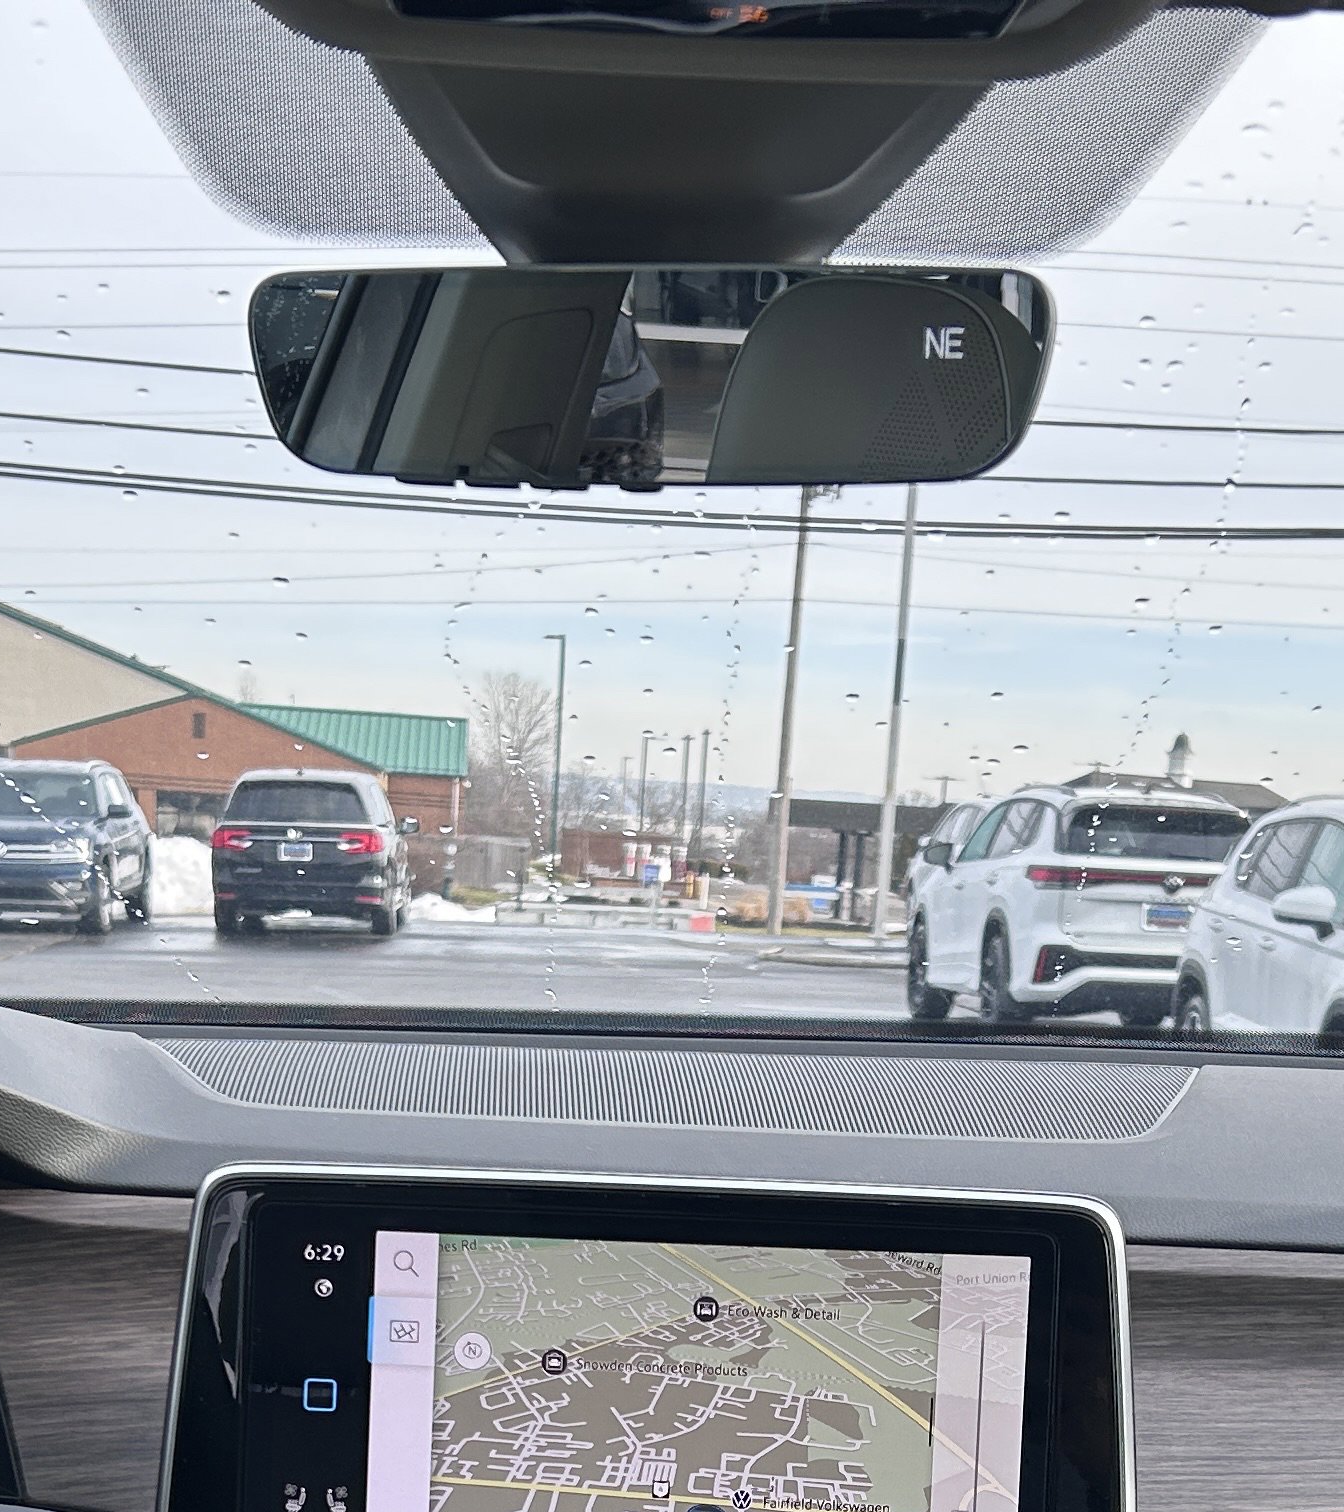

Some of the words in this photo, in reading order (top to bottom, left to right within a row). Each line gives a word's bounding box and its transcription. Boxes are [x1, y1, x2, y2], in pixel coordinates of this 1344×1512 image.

[924, 326, 965, 360] NE
[304, 1244, 345, 1261] 6:29
[461, 1239, 477, 1252] Rd
[956, 1274, 979, 1285] Port
[983, 1273, 1015, 1284] Union
[728, 1305, 750, 1317] Eco
[753, 1305, 787, 1318] Wash
[792, 1307, 800, 1319] &
[805, 1308, 840, 1321] Detail
[576, 1357, 633, 1373] Snowden
[636, 1360, 690, 1375] Concrete
[695, 1364, 748, 1377] Products
[763, 1497, 812, 1511] Fairfield
